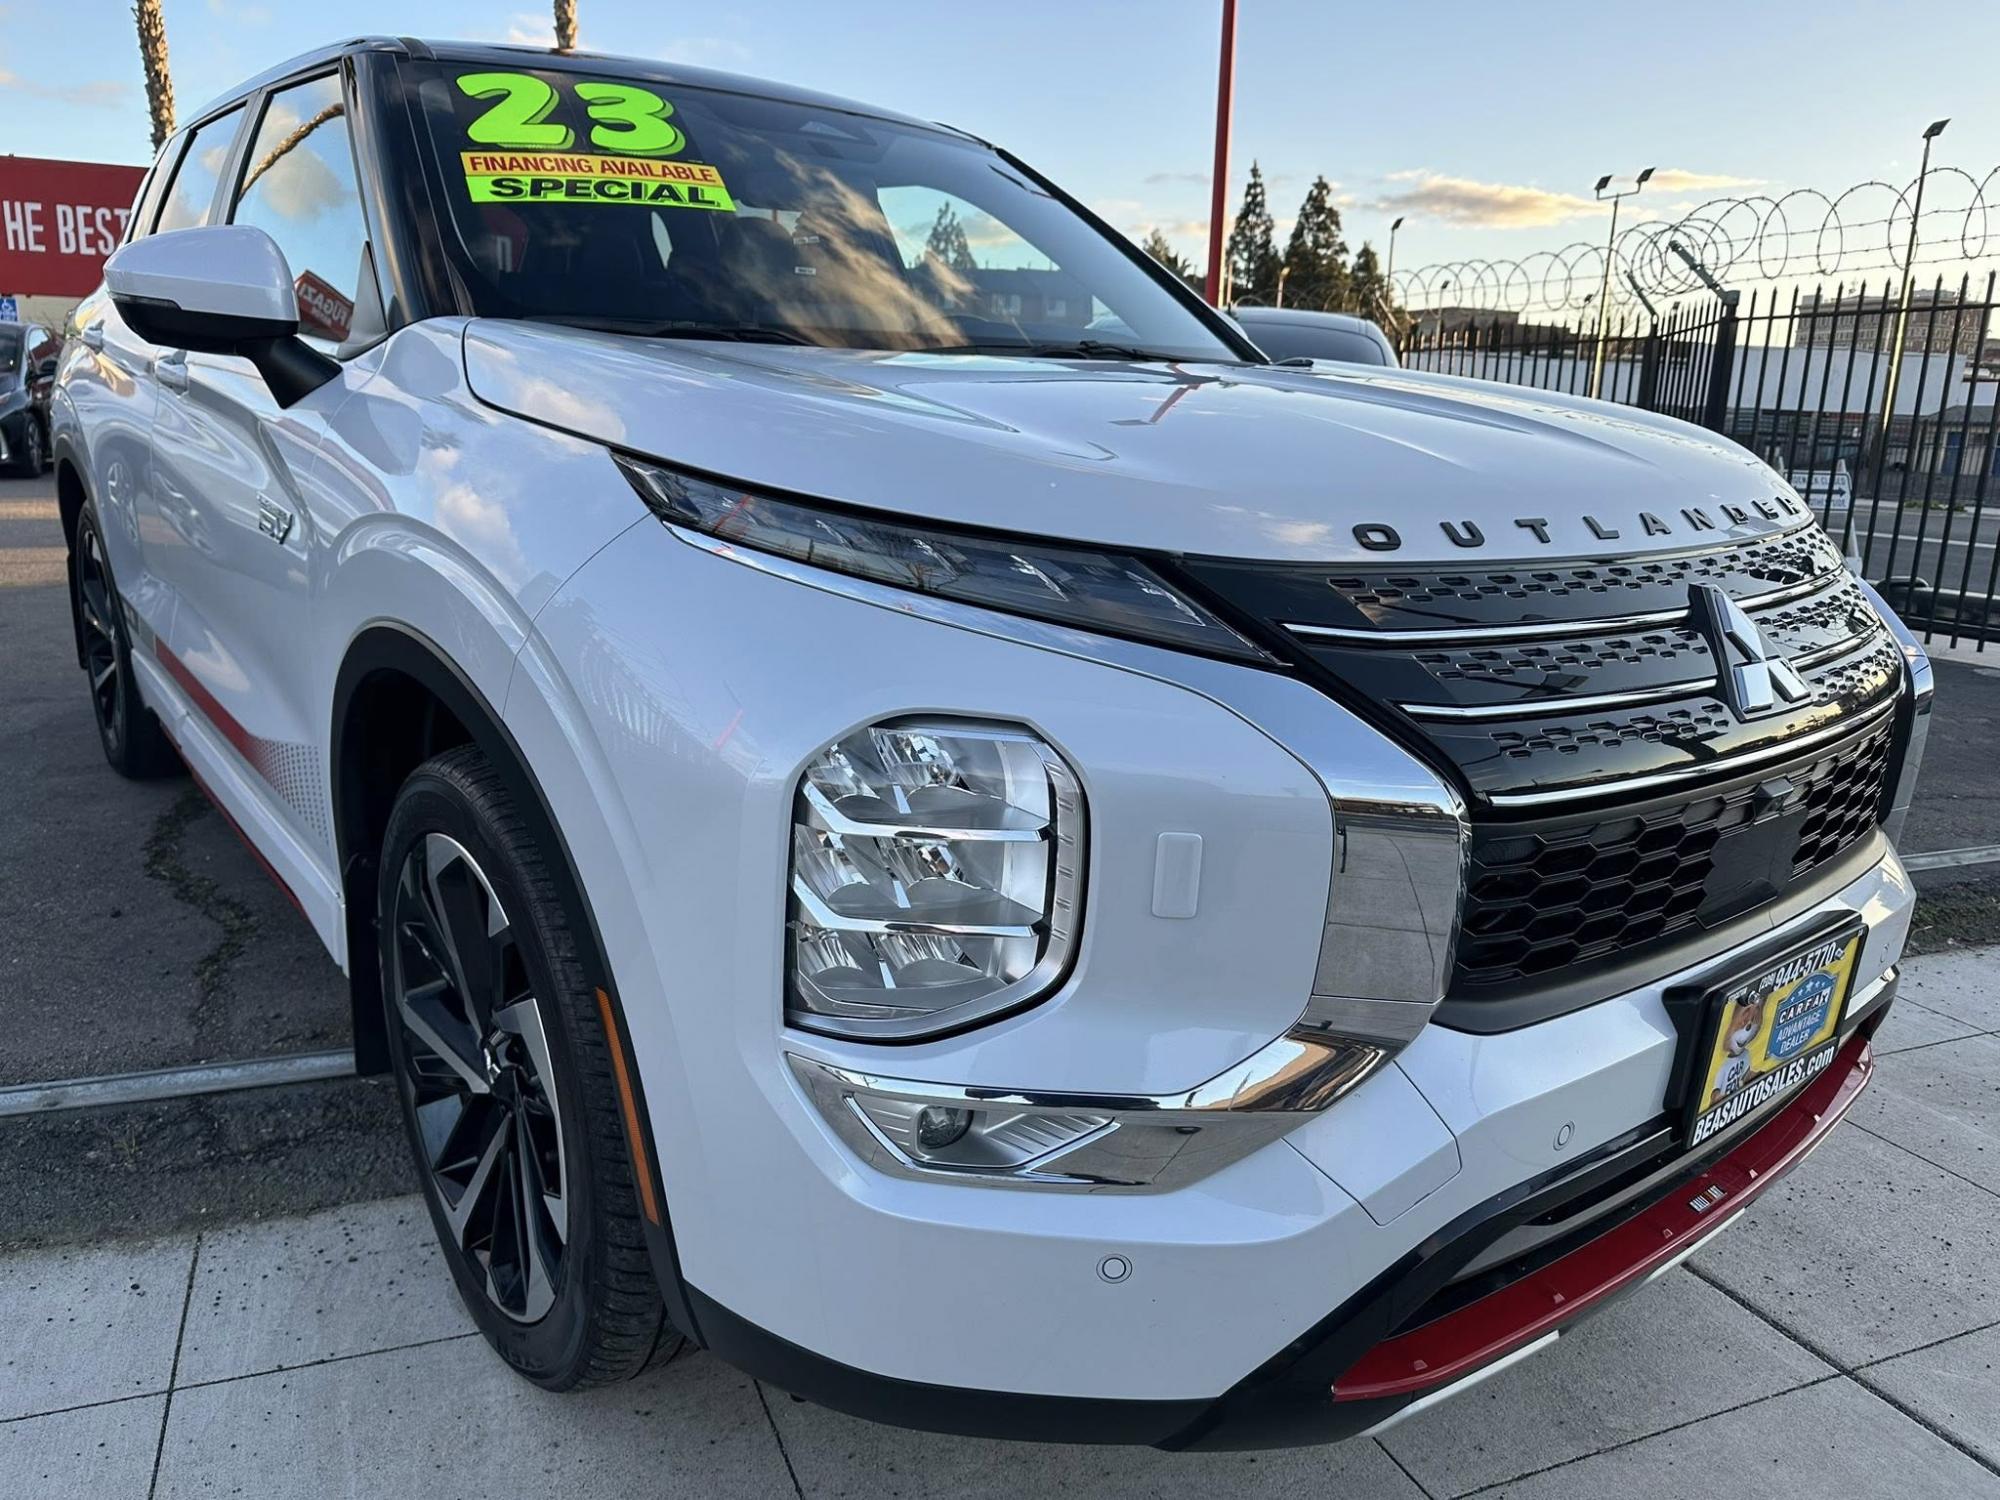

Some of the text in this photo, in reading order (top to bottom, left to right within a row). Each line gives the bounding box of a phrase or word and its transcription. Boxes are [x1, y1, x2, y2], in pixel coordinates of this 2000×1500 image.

[456, 72, 684, 156] 23
[469, 156, 717, 183] FINANCING AVAILABLE
[489, 178, 718, 206] SPECIAL
[1352, 495, 1800, 551] OUTLANDER
[1773, 941, 1837, 992] 944-5770
[1776, 1010, 1821, 1043] ADVANTAGE
[1779, 1029, 1810, 1054] DEALER
[1727, 1060, 1744, 1082] CAR
[1692, 1046, 1835, 1146] BEASAUTOSALES.com
